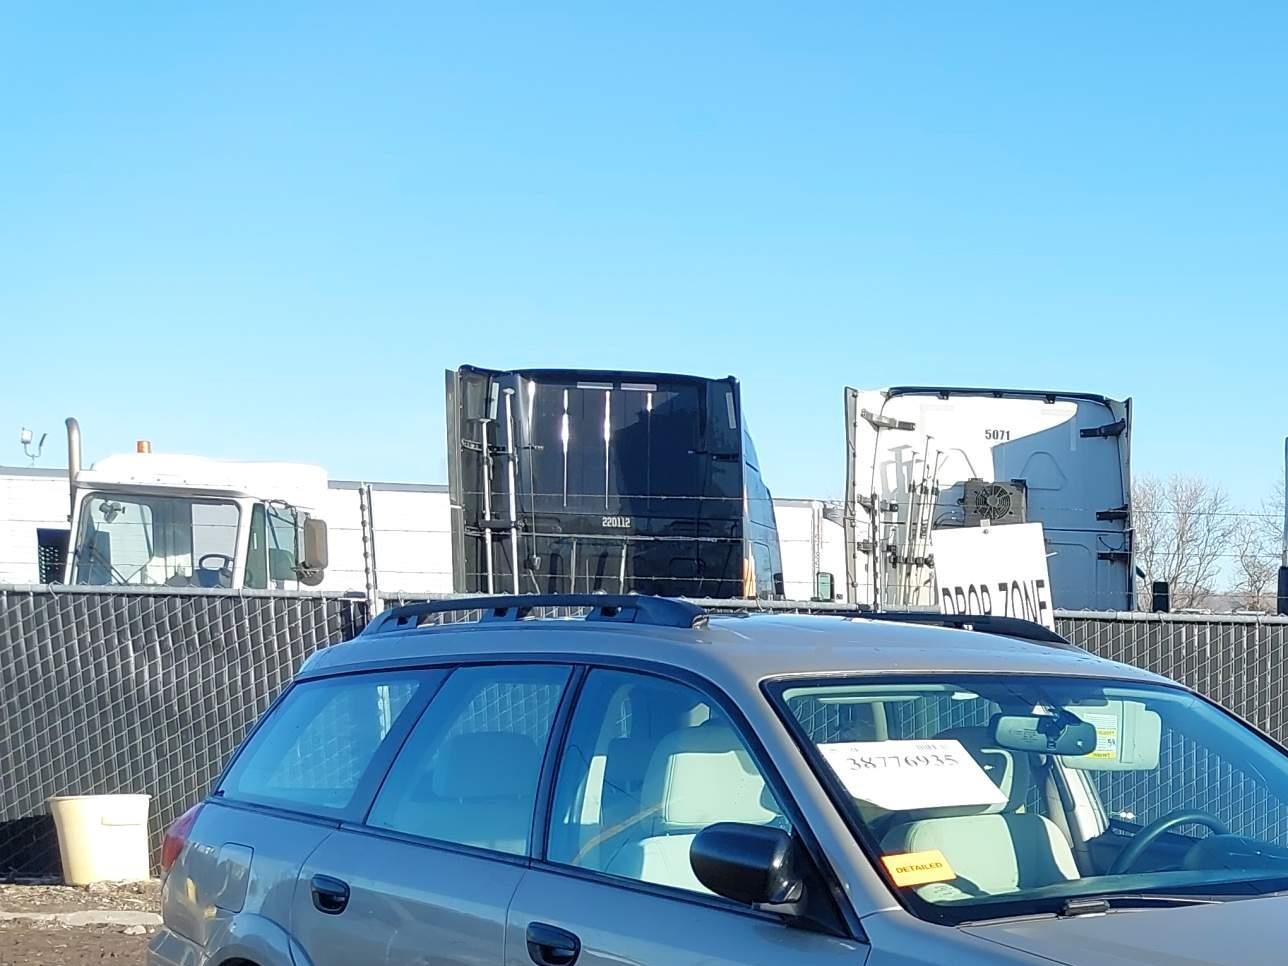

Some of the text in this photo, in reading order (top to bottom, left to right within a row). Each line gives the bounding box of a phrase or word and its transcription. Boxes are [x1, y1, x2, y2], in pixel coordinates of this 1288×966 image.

[985, 429, 1010, 441] 5071
[602, 516, 631, 528] 220112
[847, 754, 960, 771] 38776935
[895, 862, 943, 874] DETAILED
